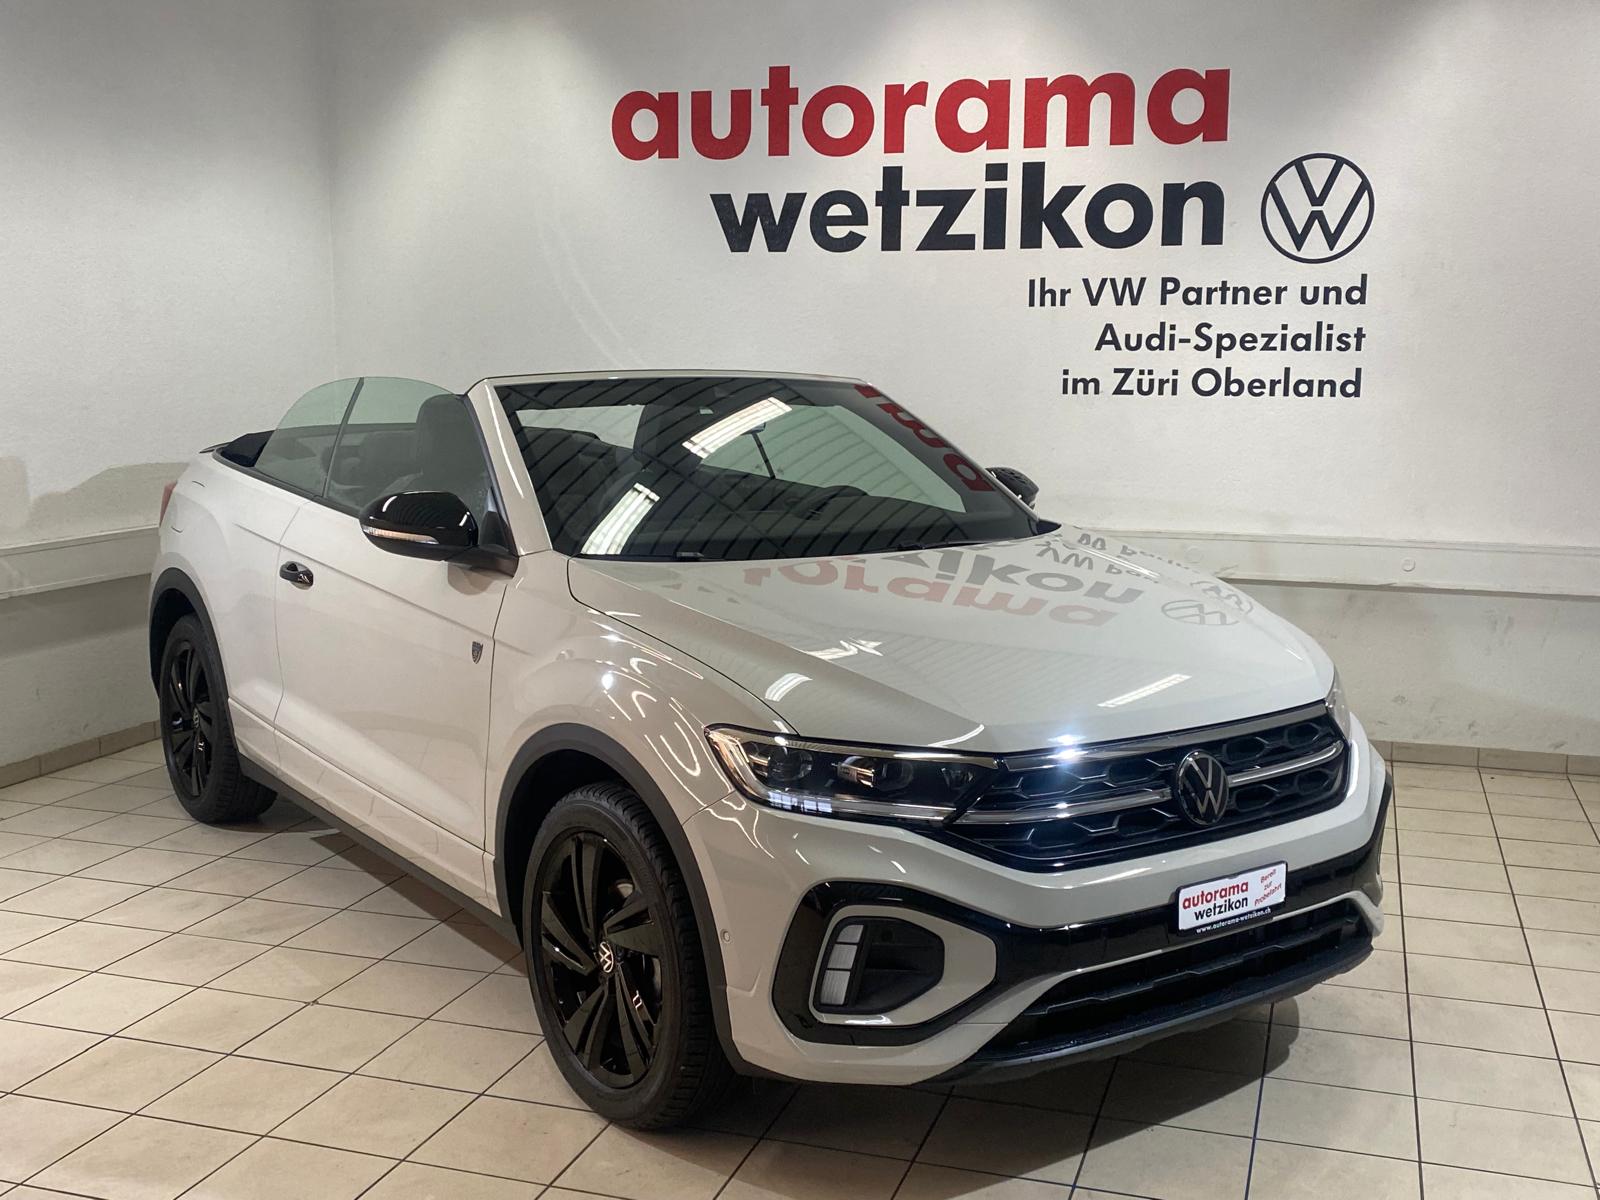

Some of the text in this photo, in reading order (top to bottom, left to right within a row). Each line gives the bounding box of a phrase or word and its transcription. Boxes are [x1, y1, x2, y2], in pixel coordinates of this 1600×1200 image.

[611, 65, 1230, 161] autorama
[709, 161, 1225, 253] wetzikon
[1028, 273, 1368, 308] Ihr VW Partner und
[1094, 320, 1366, 359] Audi-Spezialist
[1061, 366, 1362, 398] im Züri Oberland
[1182, 881, 1249, 910] autorama
[1194, 897, 1249, 921] wetzikon
[1196, 907, 1272, 934] www.autorama-wetzikon.ch
